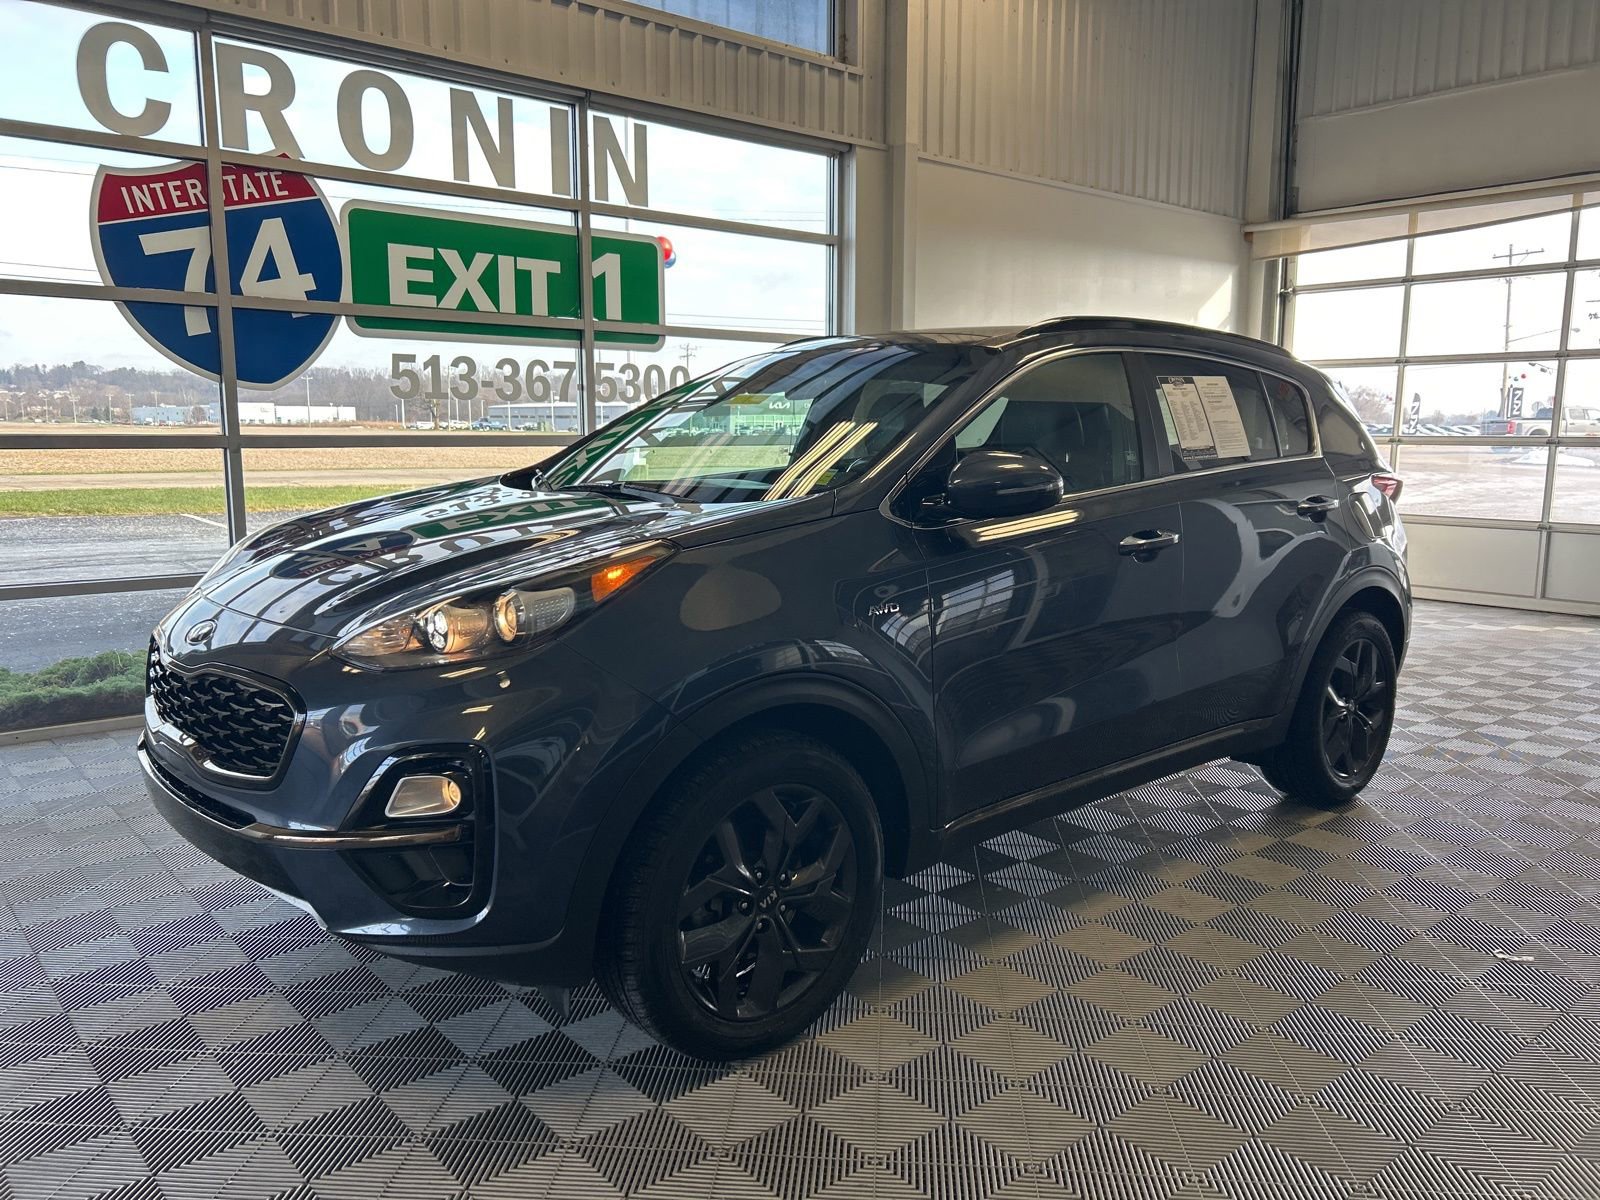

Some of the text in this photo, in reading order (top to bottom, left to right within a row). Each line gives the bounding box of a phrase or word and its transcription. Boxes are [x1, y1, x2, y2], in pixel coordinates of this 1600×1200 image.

[76, 21, 648, 208] CRONIN
[121, 171, 289, 214] INTERTATE
[138, 217, 317, 336] 74
[387, 243, 622, 321] EXIT 1
[390, 352, 691, 404] 513-3675300
[868, 602, 900, 616] AWD
